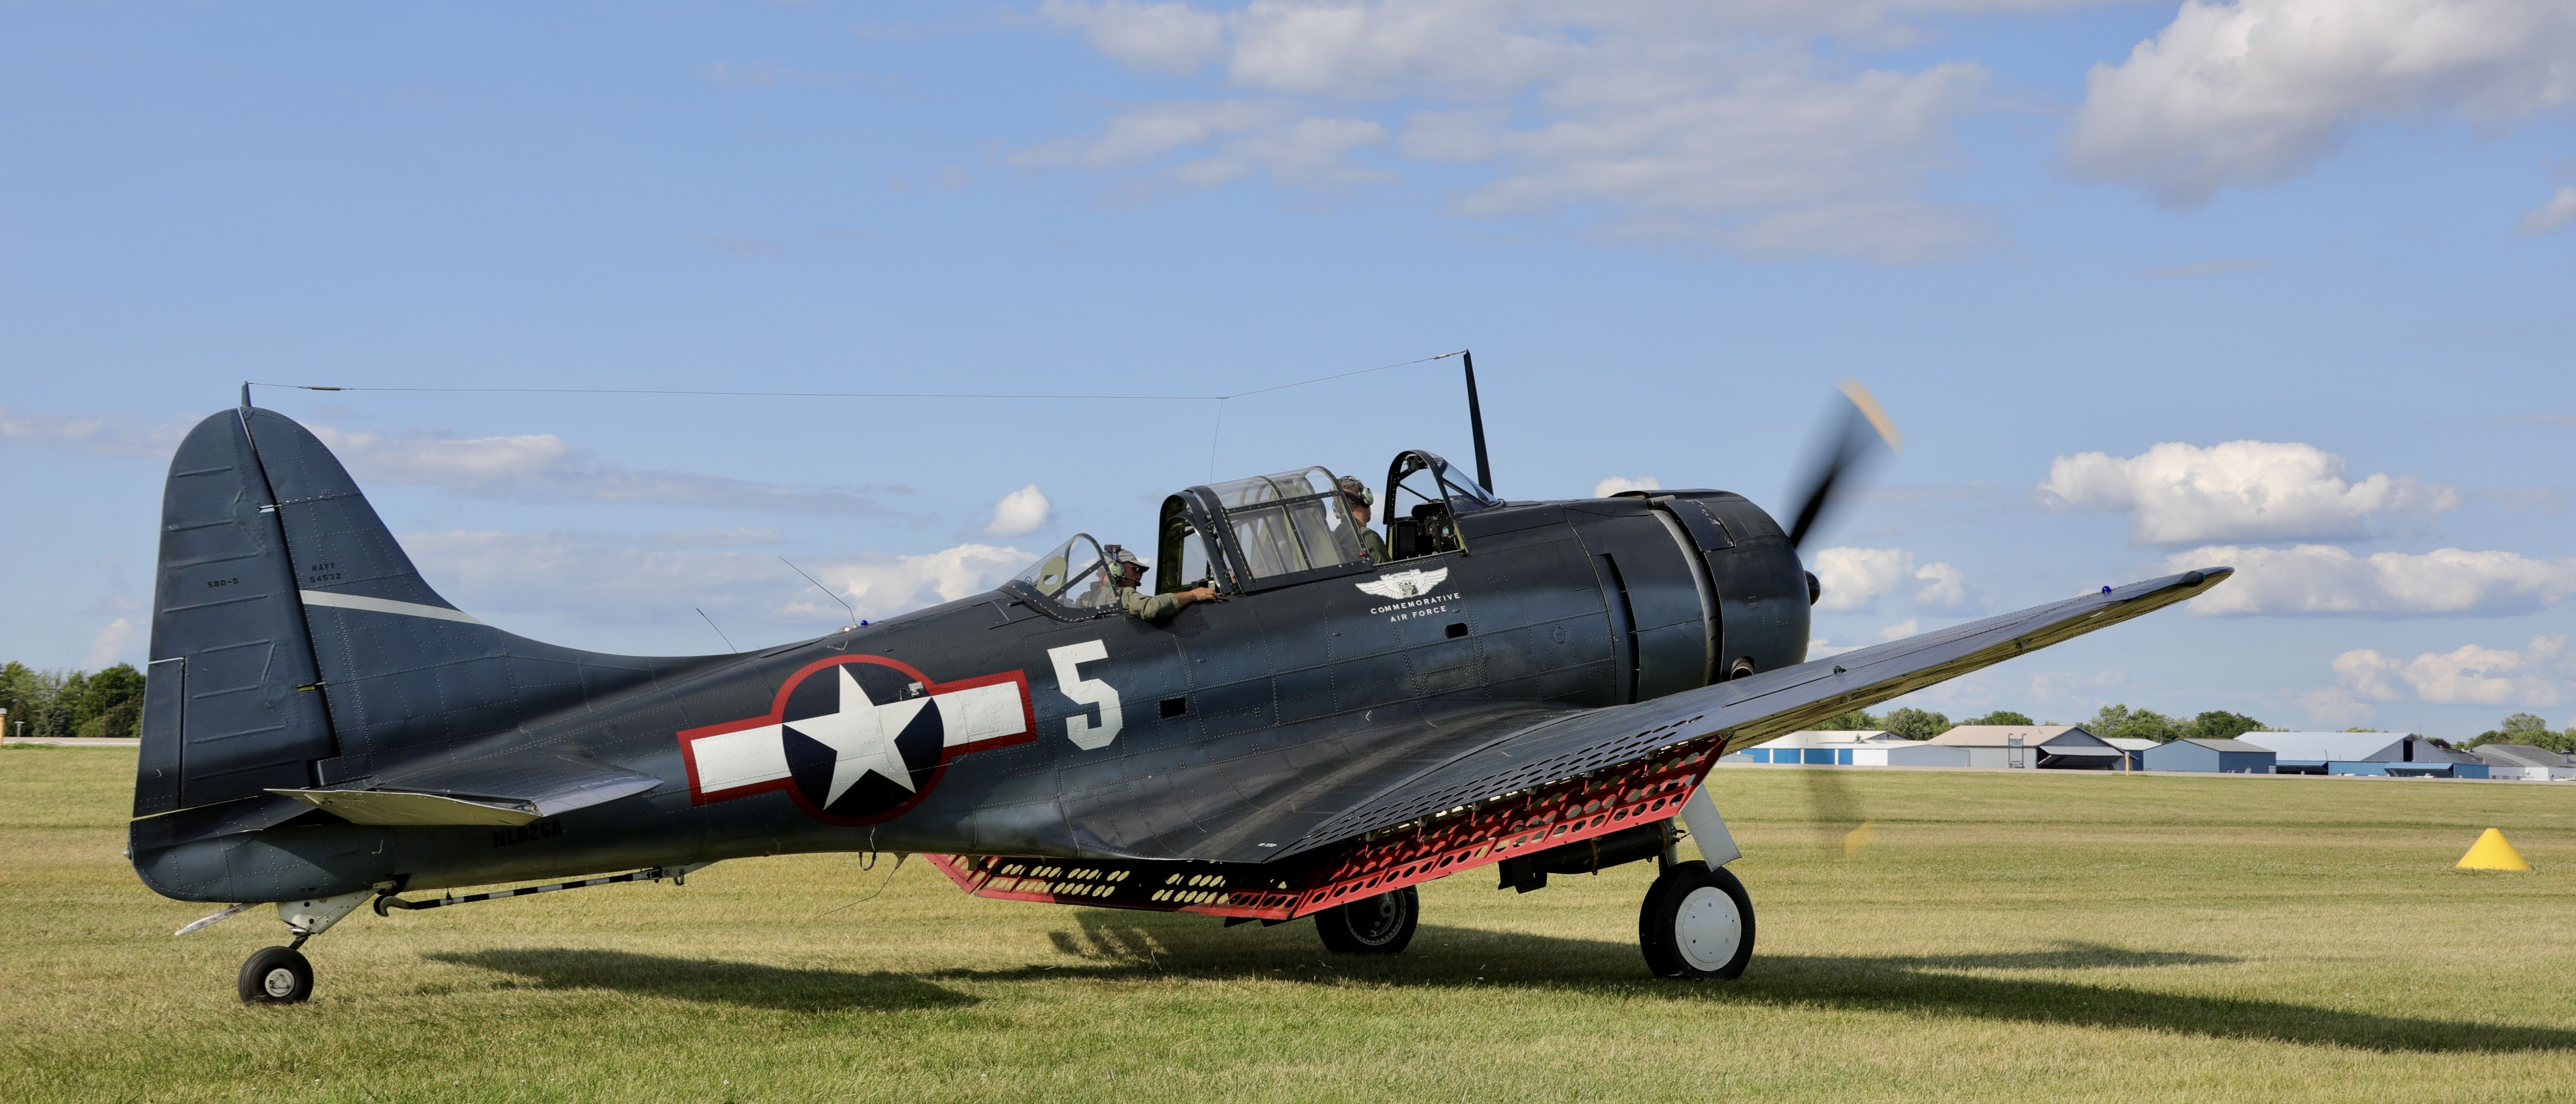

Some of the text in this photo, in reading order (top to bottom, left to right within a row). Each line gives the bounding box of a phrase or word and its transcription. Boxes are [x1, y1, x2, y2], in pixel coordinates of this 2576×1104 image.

[311, 562, 335, 571] NAVY
[207, 578, 239, 588] SBD-5
[310, 573, 341, 583] 54532
[1370, 593, 1460, 614] COMMEMORATIVE
[1391, 606, 1447, 622] AIR FORCE
[1047, 639, 1123, 750] 5
